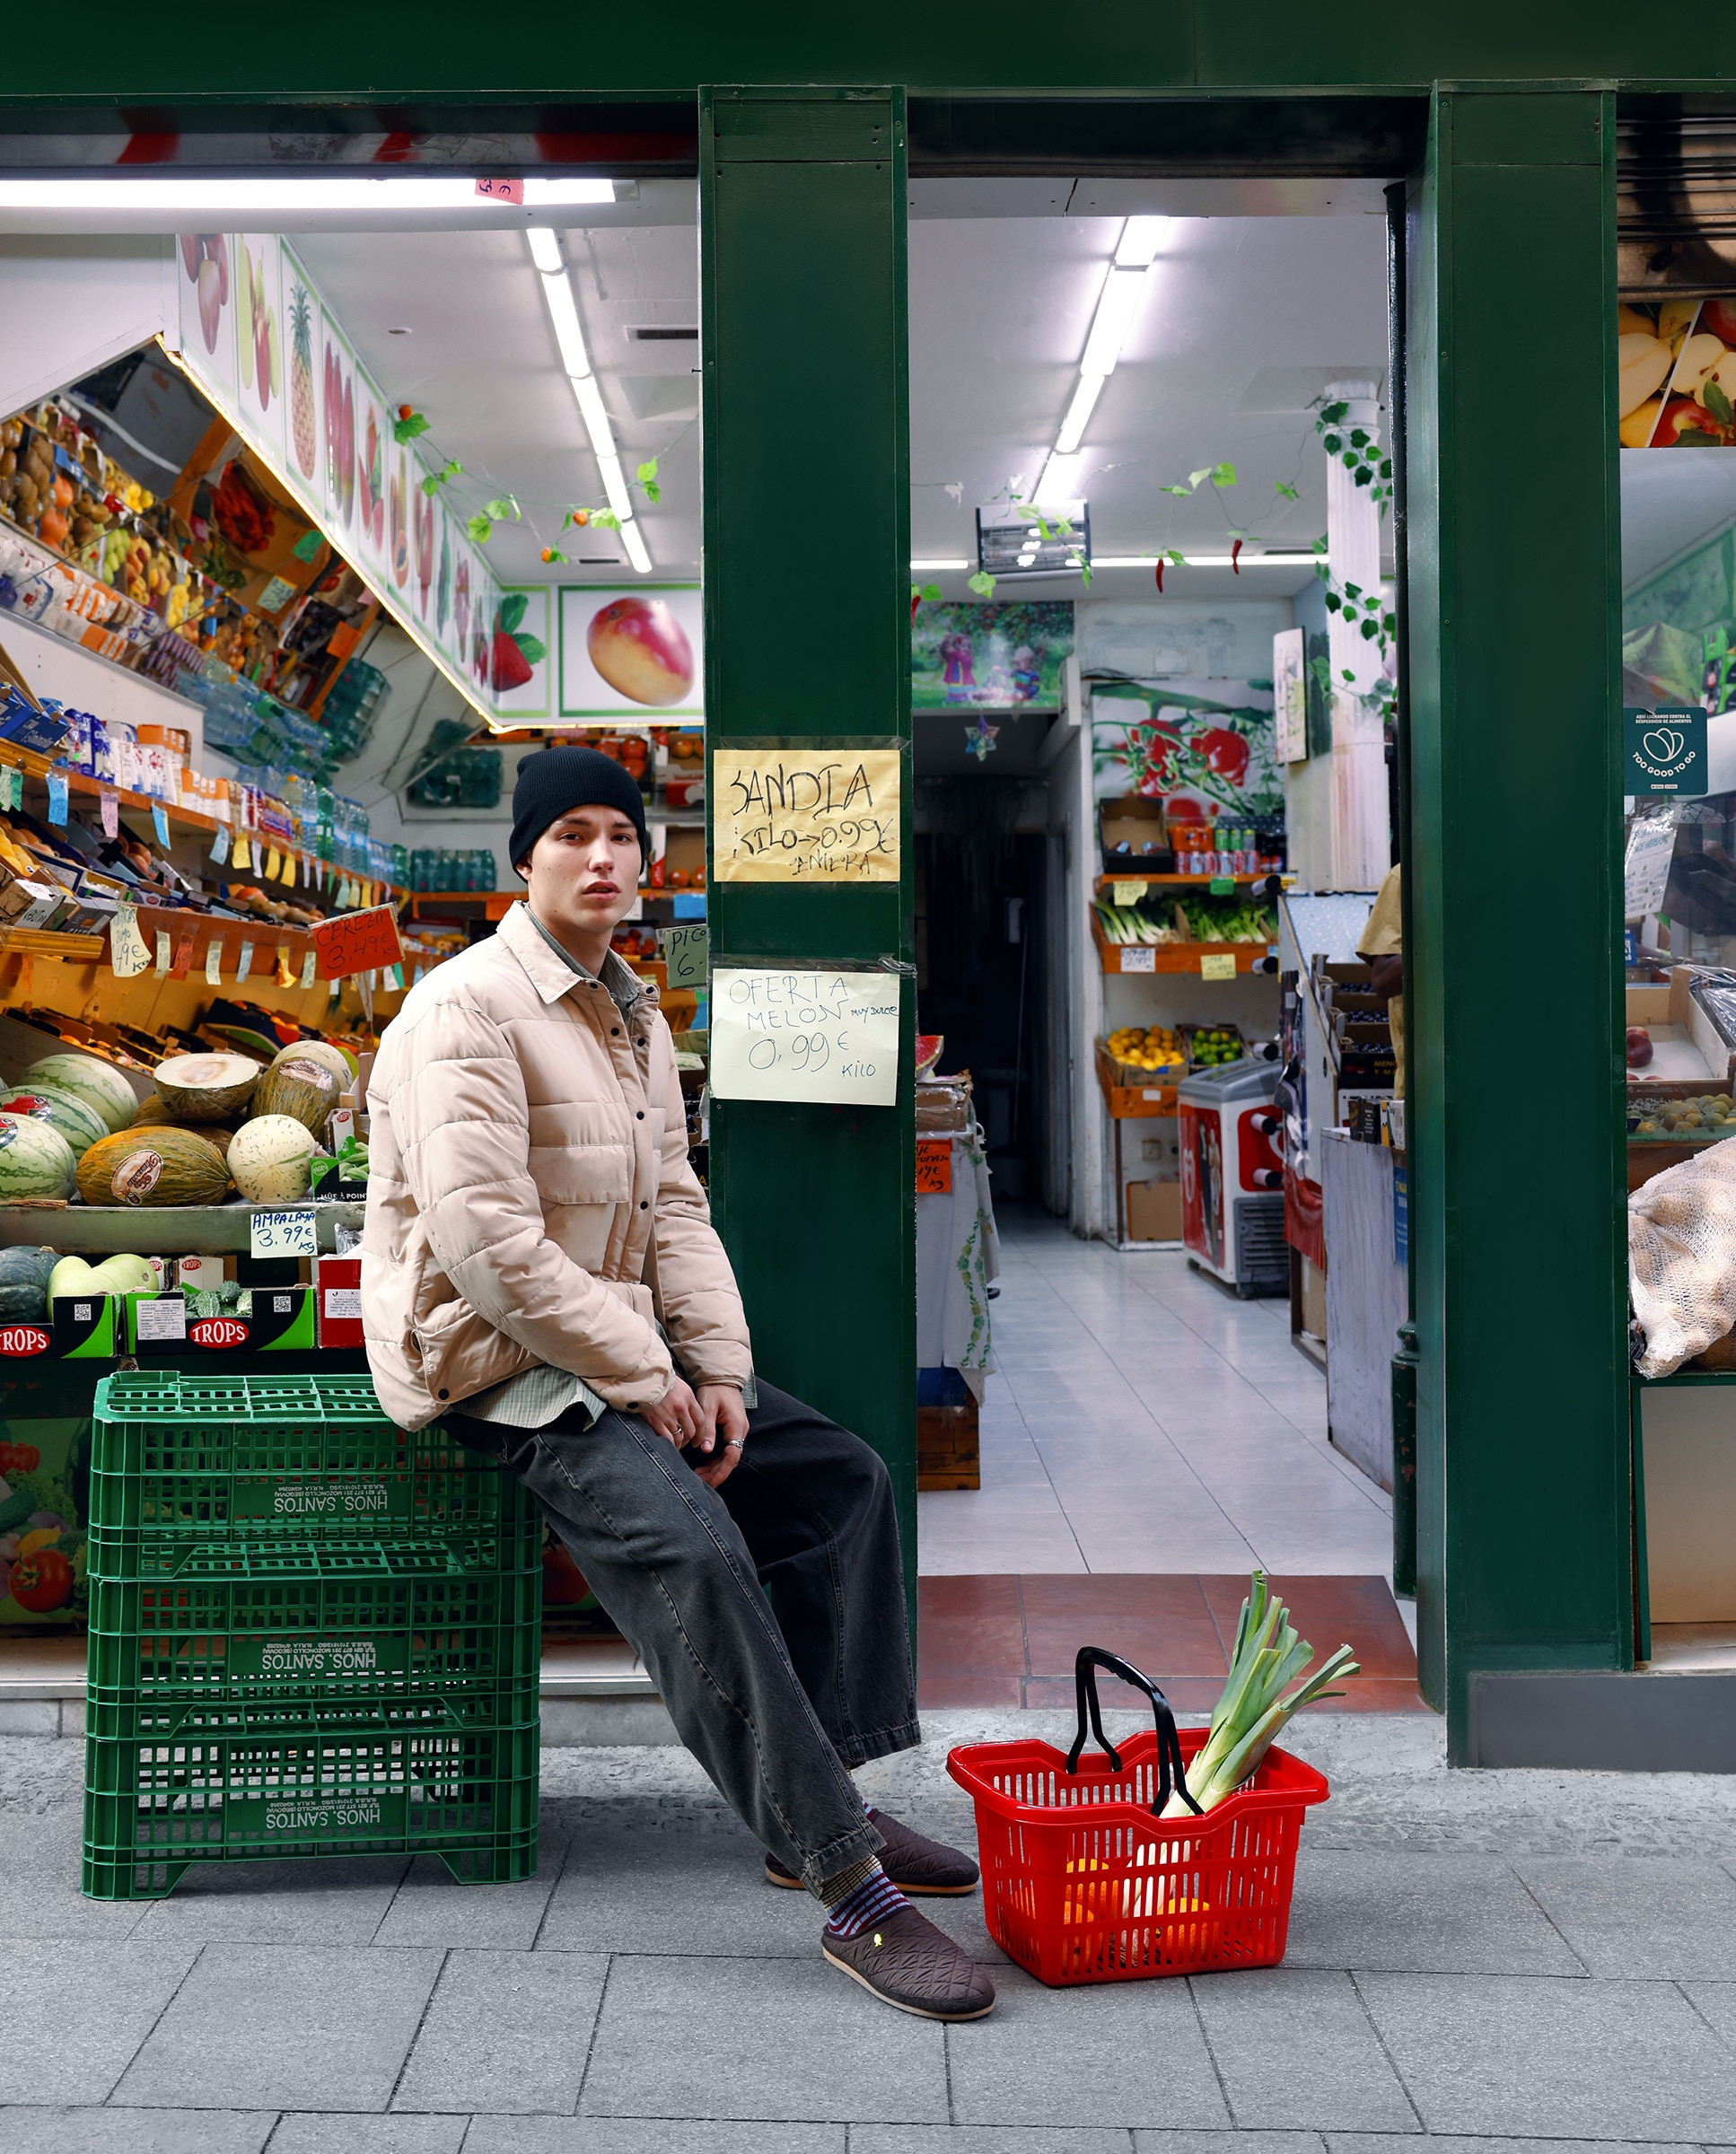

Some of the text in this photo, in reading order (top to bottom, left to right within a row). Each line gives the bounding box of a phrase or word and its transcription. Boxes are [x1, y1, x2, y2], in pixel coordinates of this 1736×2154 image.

[1633, 750, 1696, 777] TOO GOOD TO GO
[731, 764, 872, 820] SANDIA
[317, 911, 383, 947] CEREZA
[730, 976, 848, 1004] OFERTA
[748, 999, 848, 1029] MELON
[851, 1007, 869, 1023] MUY
[252, 1212, 315, 1230] AMPALAYA
[0, 1328, 47, 1352] ROPS
[192, 1320, 246, 1344] TROPS
[274, 1495, 388, 1513] HNOS. SANTOS
[262, 1653, 376, 1669] HNOS. SANTOS
[266, 1808, 381, 1829] HNOS. SANTOS
